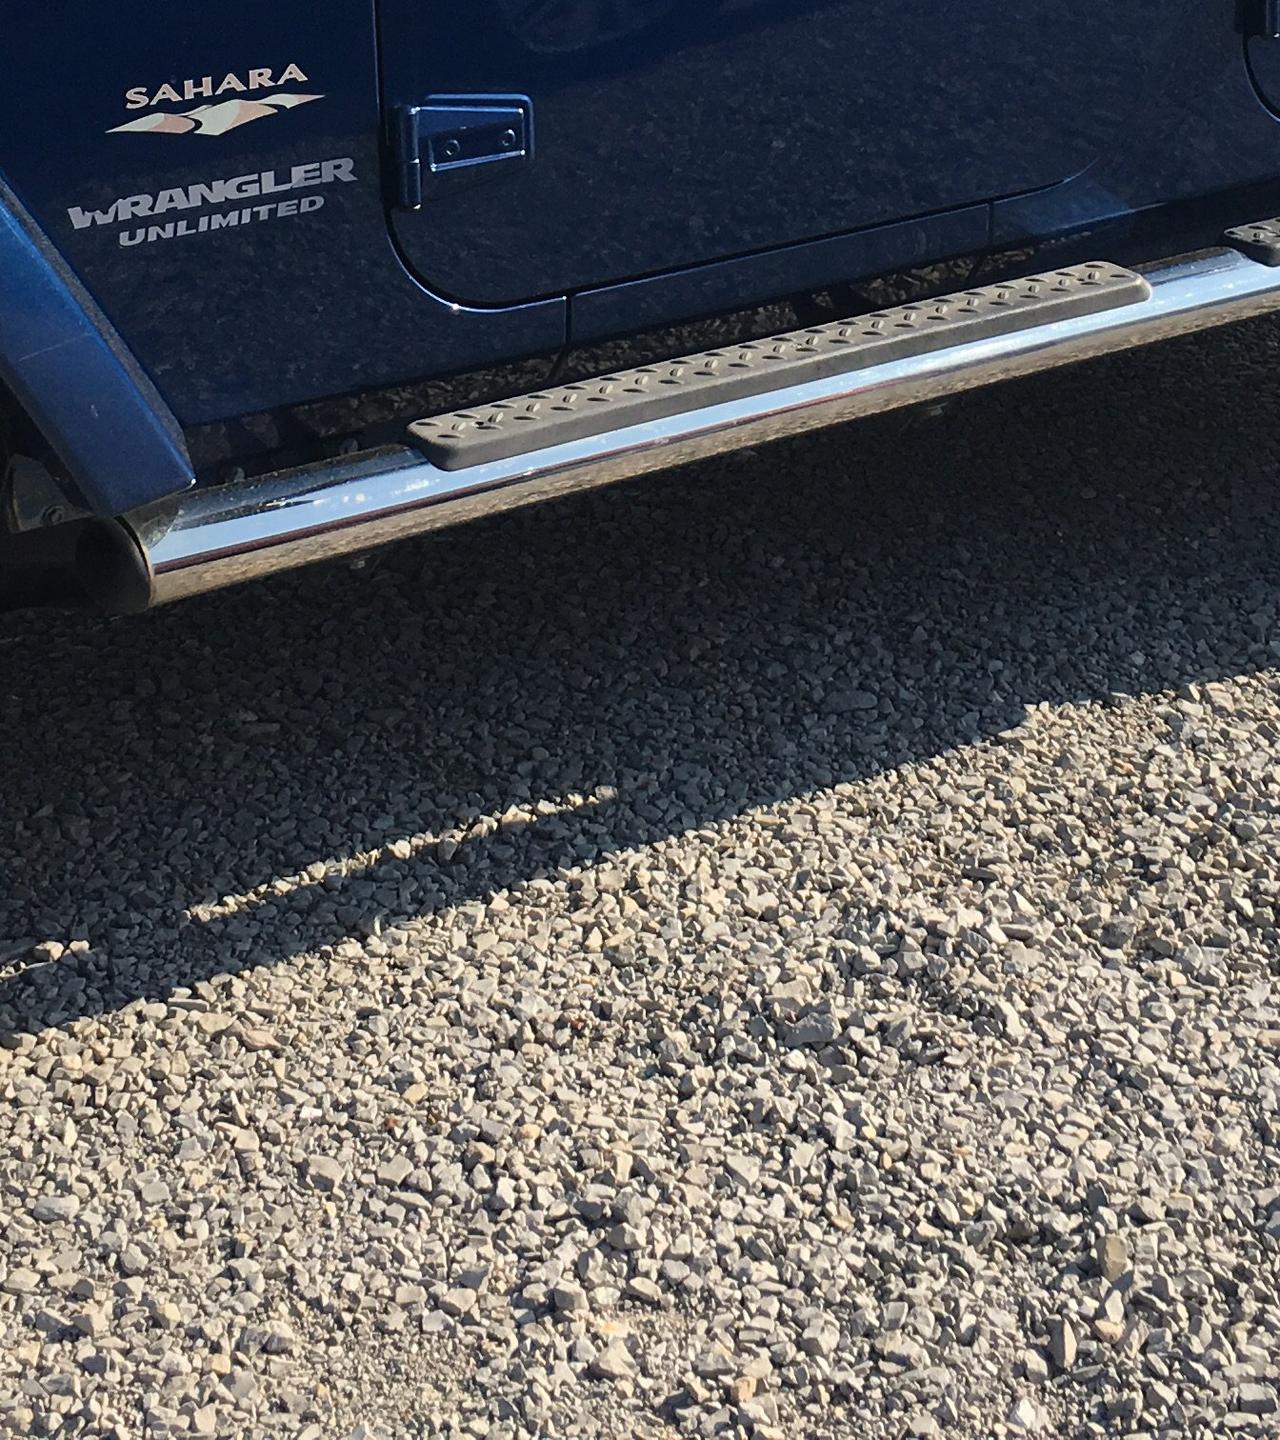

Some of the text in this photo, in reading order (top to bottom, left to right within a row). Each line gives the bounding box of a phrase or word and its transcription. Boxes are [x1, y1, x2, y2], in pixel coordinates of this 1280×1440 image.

[125, 63, 308, 110] SAHARA
[67, 157, 359, 230] WRANGLER
[119, 195, 325, 247] UNLIMITED
